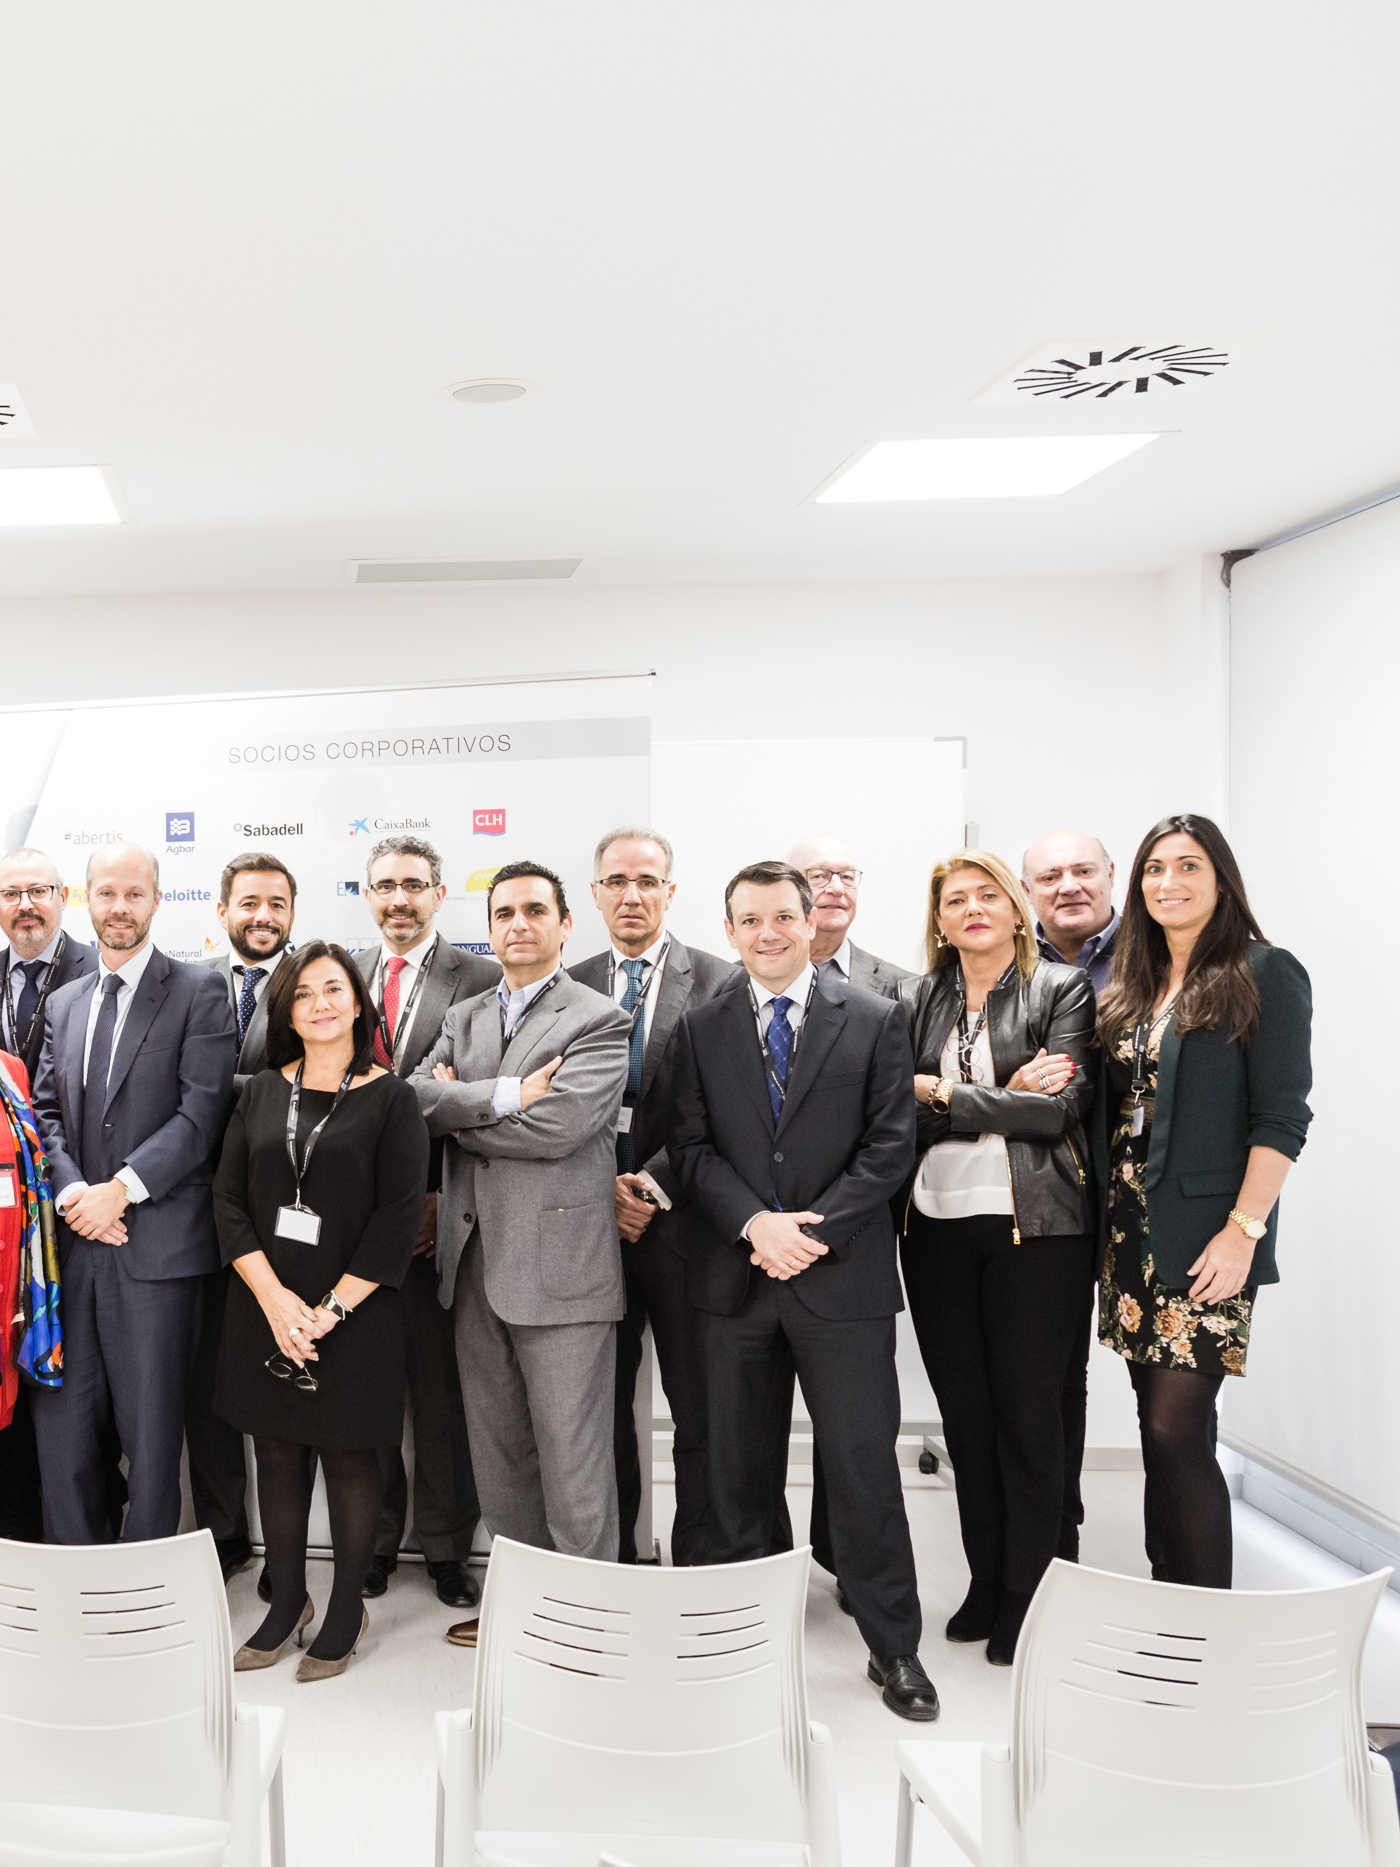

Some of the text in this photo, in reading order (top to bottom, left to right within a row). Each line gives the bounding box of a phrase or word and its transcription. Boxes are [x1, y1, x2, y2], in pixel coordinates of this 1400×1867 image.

[228, 734, 512, 764] SOCIOS CORPORATIVOS
[374, 818, 431, 830] CaixaBank
[474, 813, 503, 827] CLH
[243, 823, 304, 837] Sabadell
[73, 831, 125, 845] abertis
[160, 888, 212, 902] eloitte
